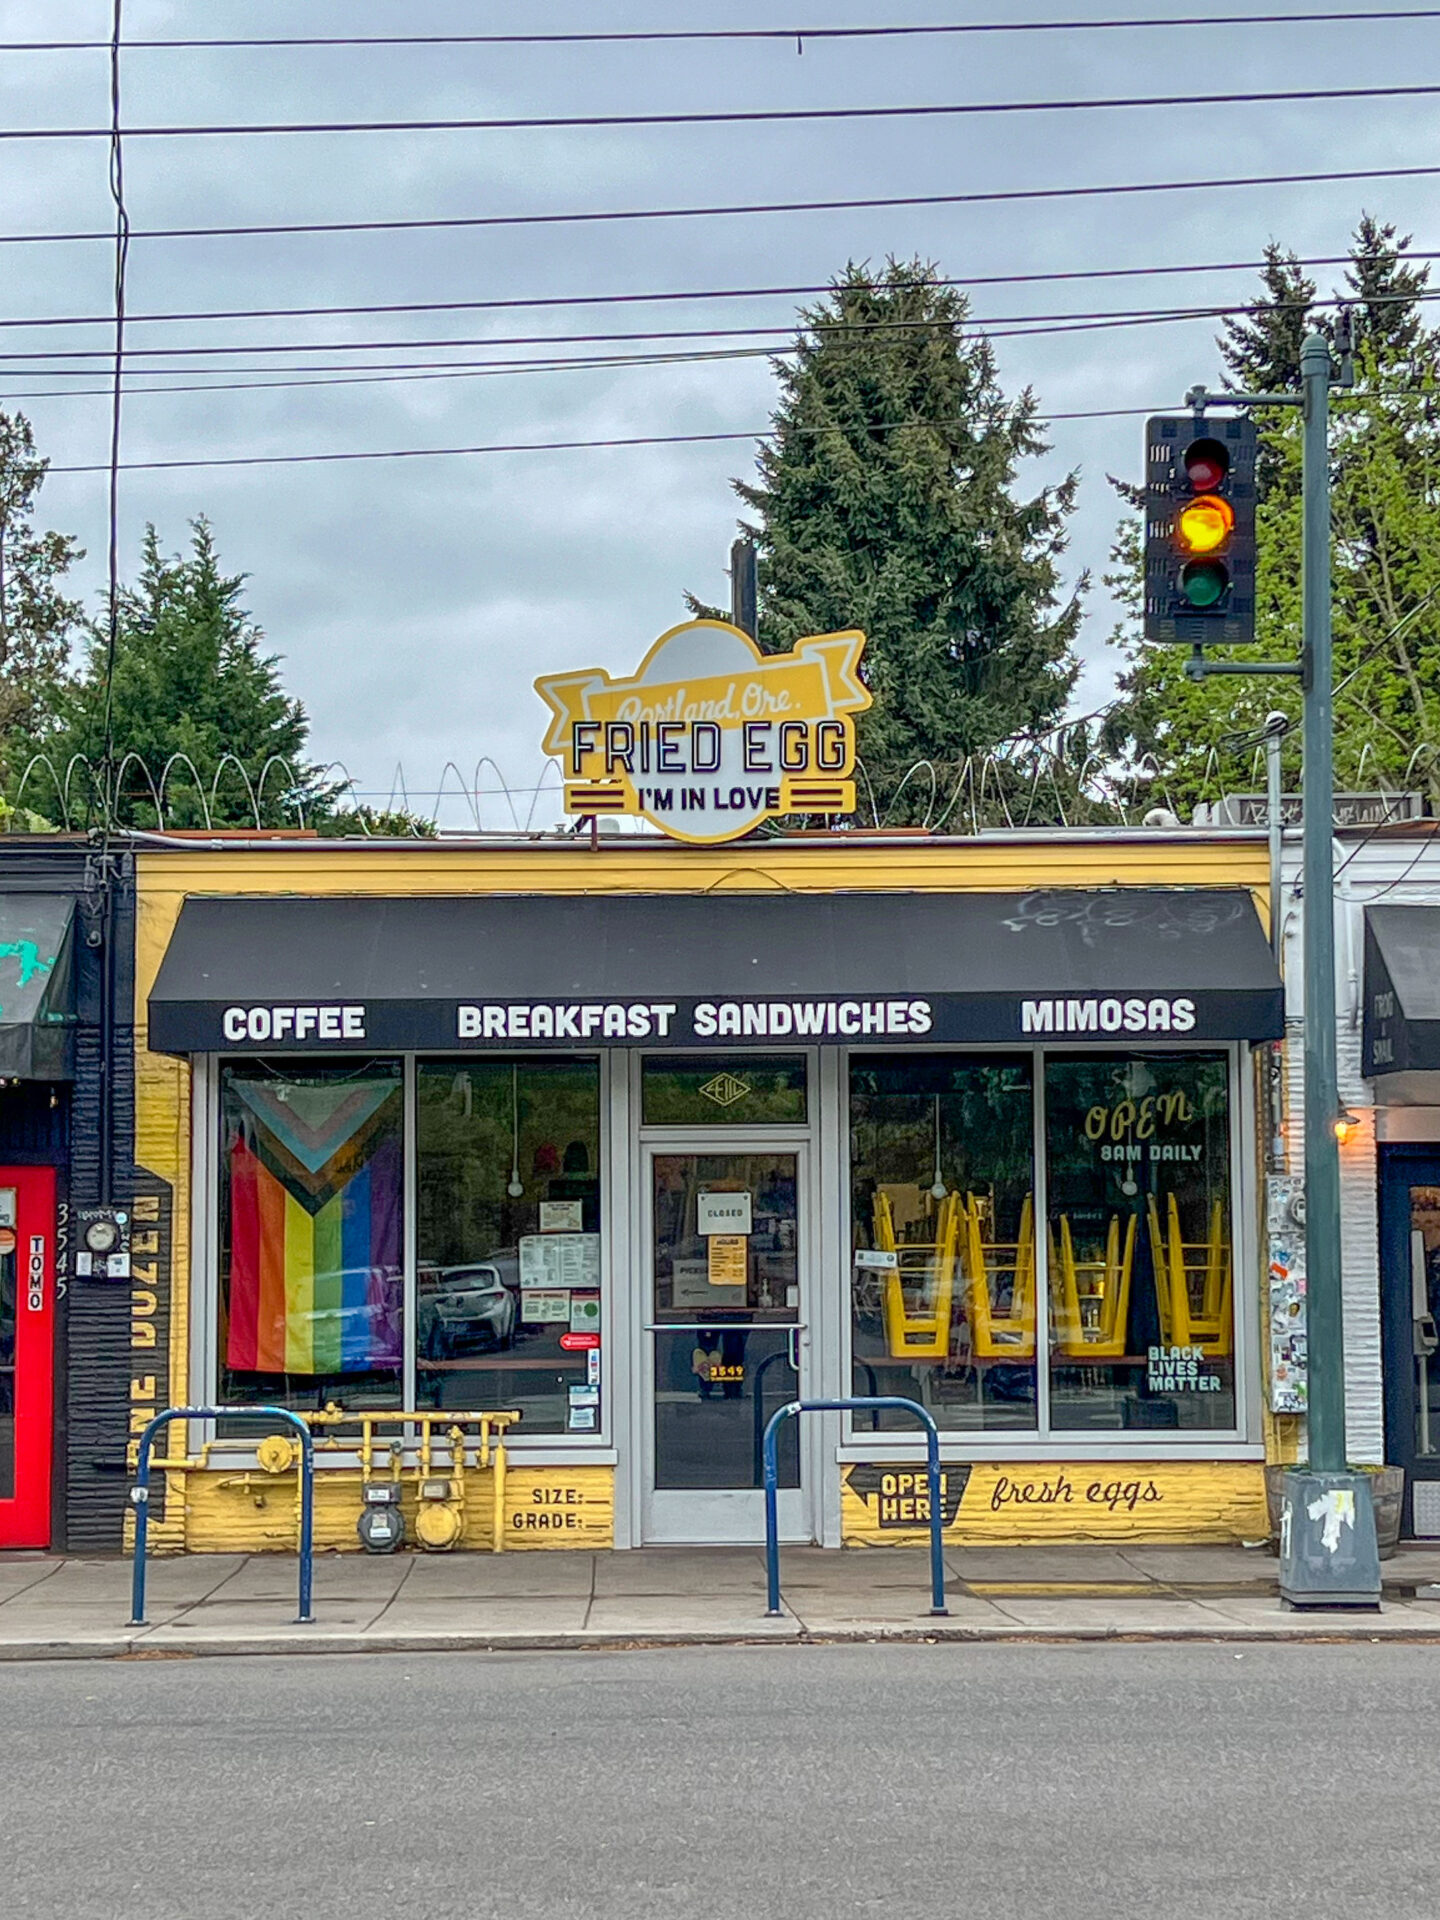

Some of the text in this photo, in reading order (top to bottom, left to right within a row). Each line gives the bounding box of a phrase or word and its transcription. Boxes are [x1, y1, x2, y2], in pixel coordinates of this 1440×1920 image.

[743, 683, 801, 717] Ore.
[572, 720, 846, 773] FRIED EGG
[639, 786, 780, 810] I'M IN LOVE
[223, 1006, 366, 1041] COFFEE
[457, 1001, 933, 1038] BREAKFAST SANDWICHES
[1021, 999, 1196, 1032] MIMOSAS
[1100, 1145, 1202, 1161] 8AM DAILY
[56, 1203, 69, 1300] 3545
[28, 1237, 42, 1309] TOMO
[1148, 1346, 1204, 1361] BLACK
[1149, 1362, 1198, 1376] LIVES
[1149, 1376, 1221, 1392] MATTER
[991, 1477, 1163, 1511] fresh eggs
